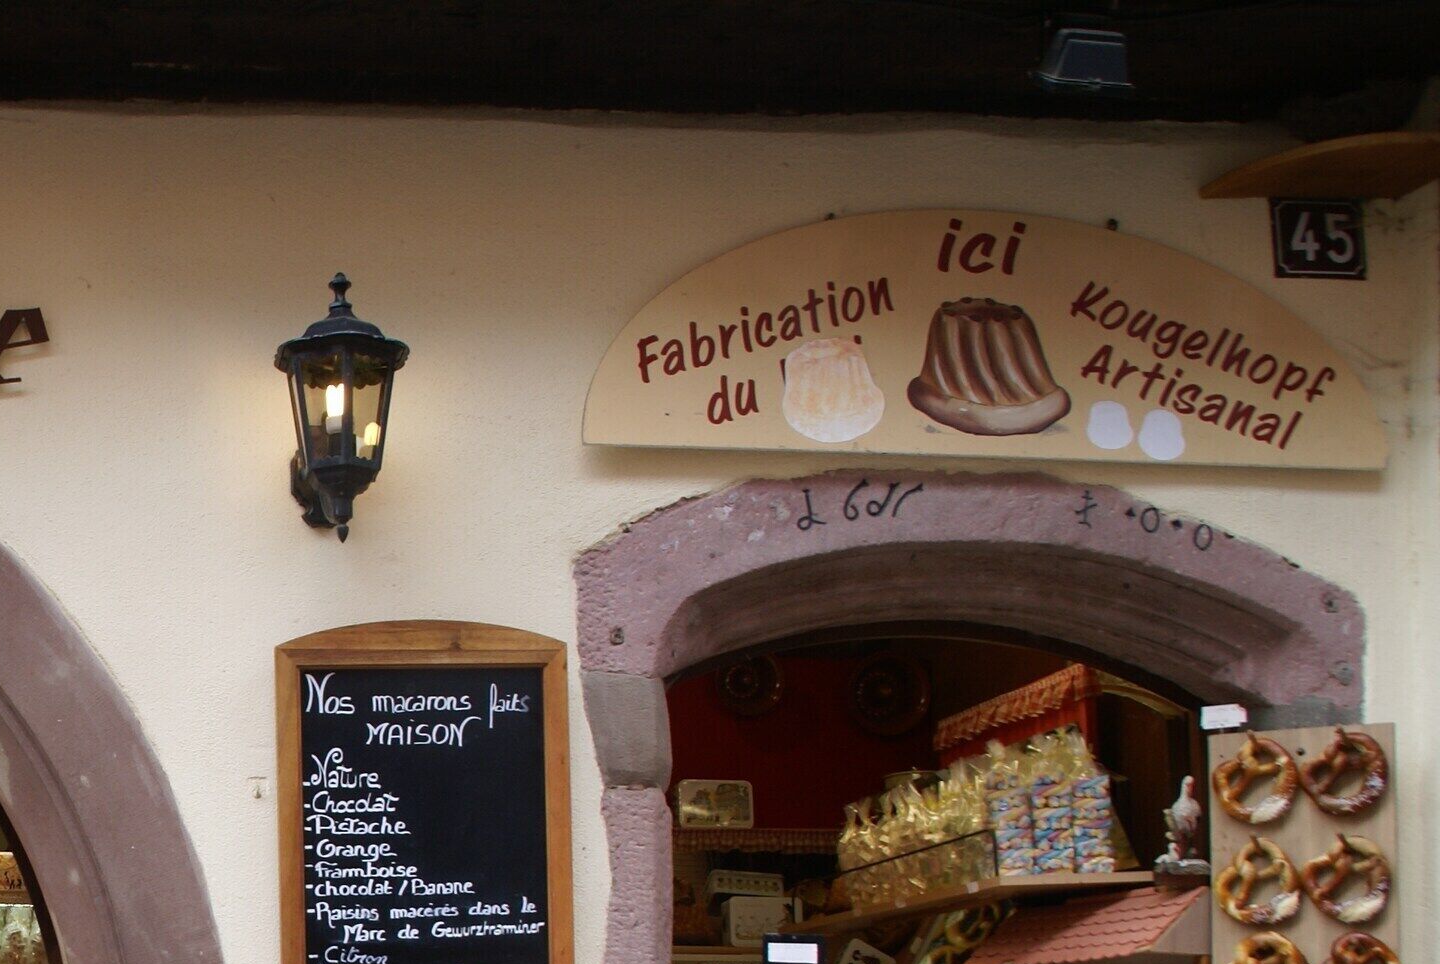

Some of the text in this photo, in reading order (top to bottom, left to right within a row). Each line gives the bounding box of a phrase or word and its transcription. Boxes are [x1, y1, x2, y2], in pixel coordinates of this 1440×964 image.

[937, 217, 1027, 275] ici
[1289, 210, 1359, 265] 45
[637, 276, 895, 384] Fabrication
[1070, 281, 1337, 403] Kougelhopf
[706, 374, 760, 425] du
[1080, 344, 1304, 451] Artisanal
[305, 672, 532, 729] Nos macarons faits
[411, 878, 476, 897] Banane
[468, 901, 511, 917] dans
[342, 923, 387, 944] Marc
[397, 923, 420, 940] de
